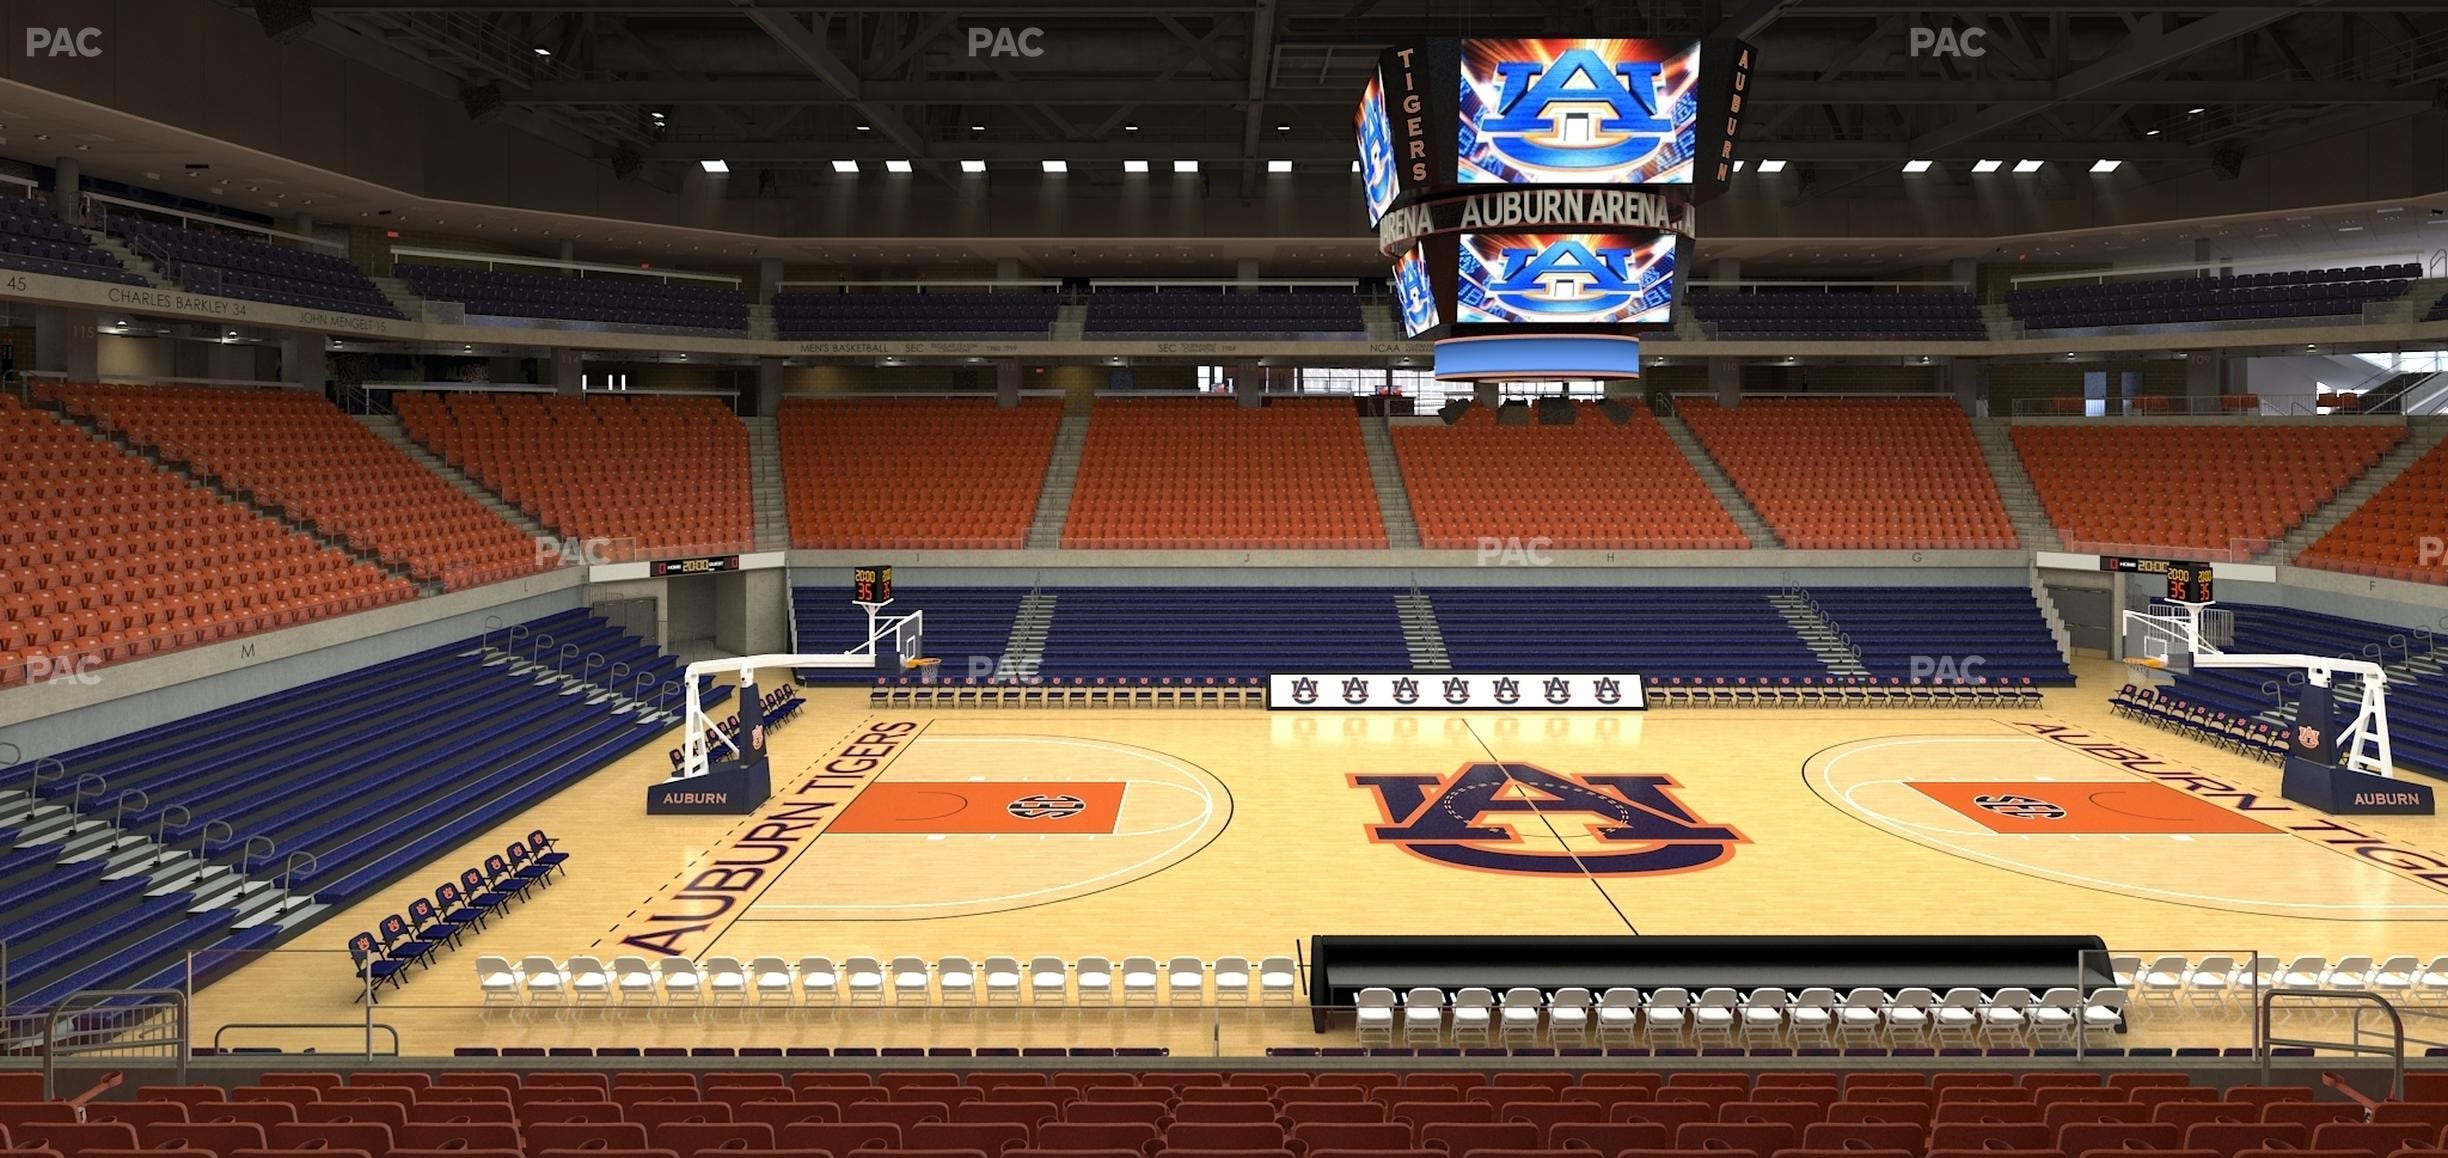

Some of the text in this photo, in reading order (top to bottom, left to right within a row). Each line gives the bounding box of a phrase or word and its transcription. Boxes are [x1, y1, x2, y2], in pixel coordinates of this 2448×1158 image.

[1397, 48, 1427, 181] TIGERS
[1717, 49, 1748, 181] AUBURN
[1460, 189, 1583, 229] AUBURN
[1588, 189, 1670, 232] ARENA
[7, 276, 27, 292] 45
[108, 288, 247, 316] CHARLES BARKLEY 34
[300, 311, 328, 325] JOHN
[376, 320, 387, 332] 15
[801, 343, 829, 353] MEN'S
[832, 343, 888, 353] BASKETBALL
[905, 343, 924, 353] SEC
[1158, 344, 1177, 353] SEC
[1370, 344, 1401, 353] NCAA
[1607, 552, 1615, 562] H
[1912, 552, 1922, 562] G
[2168, 568, 2189, 582] 20:00
[858, 582, 872, 600] 35
[2171, 581, 2186, 599] 35
[2200, 583, 2210, 600] 35
[2369, 580, 2376, 592] F
[241, 643, 256, 659] M
[2012, 721, 2293, 811] AUBURN
[663, 793, 727, 804] AUBURN
[2354, 793, 2420, 805] AUBURN
[617, 802, 837, 956] AUBURN
[795, 721, 917, 794] TIGERS
